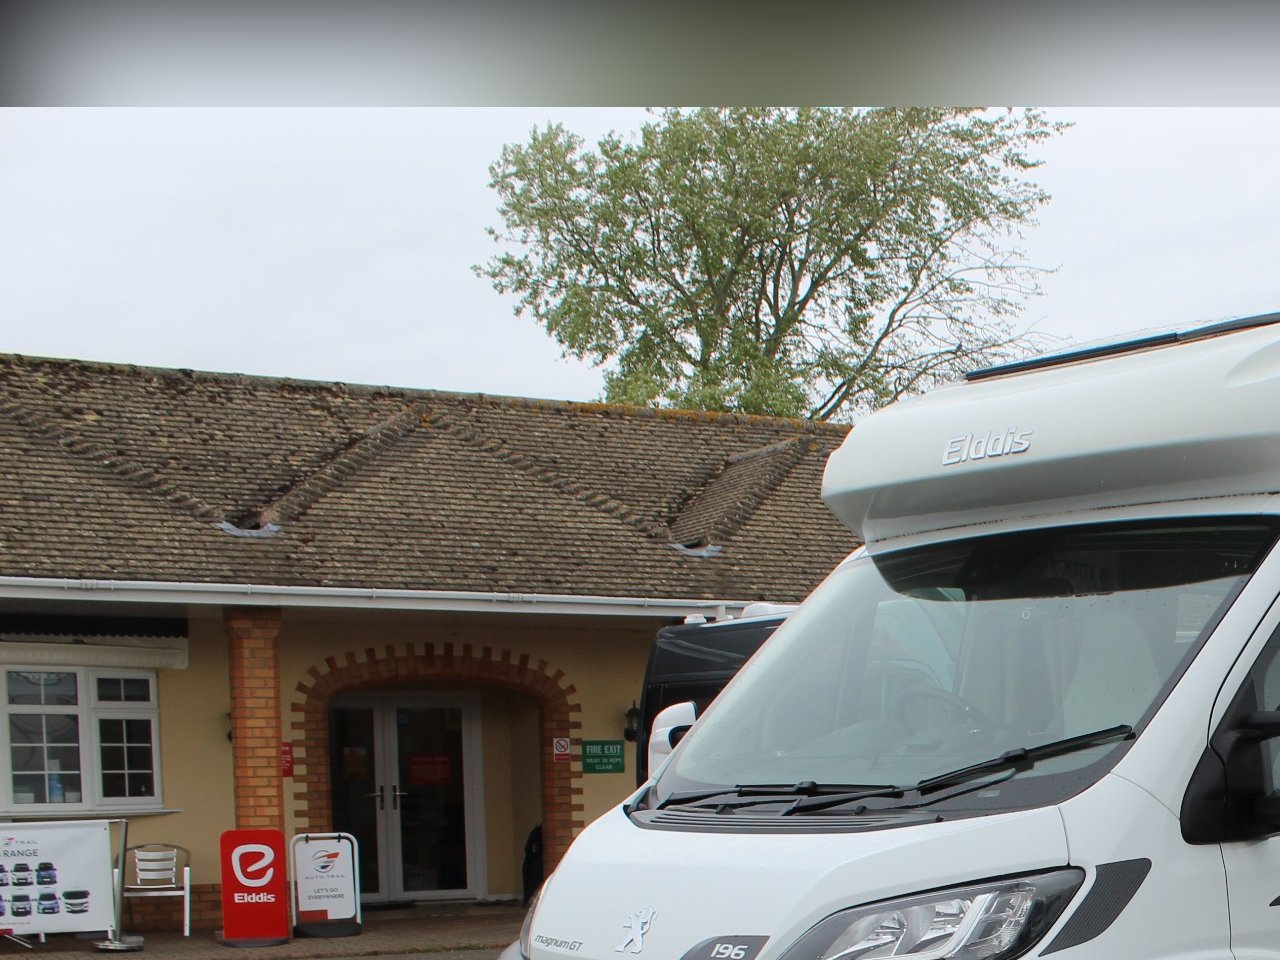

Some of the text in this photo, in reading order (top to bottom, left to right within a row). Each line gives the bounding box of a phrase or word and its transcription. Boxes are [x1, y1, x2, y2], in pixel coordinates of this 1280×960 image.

[942, 427, 1033, 466] Elddis
[586, 745, 621, 754] FIRE EXIT
[3, 848, 39, 857] RANGE
[233, 892, 276, 904] Elddis
[535, 934, 583, 951] magnum GT
[710, 943, 749, 960] 196
